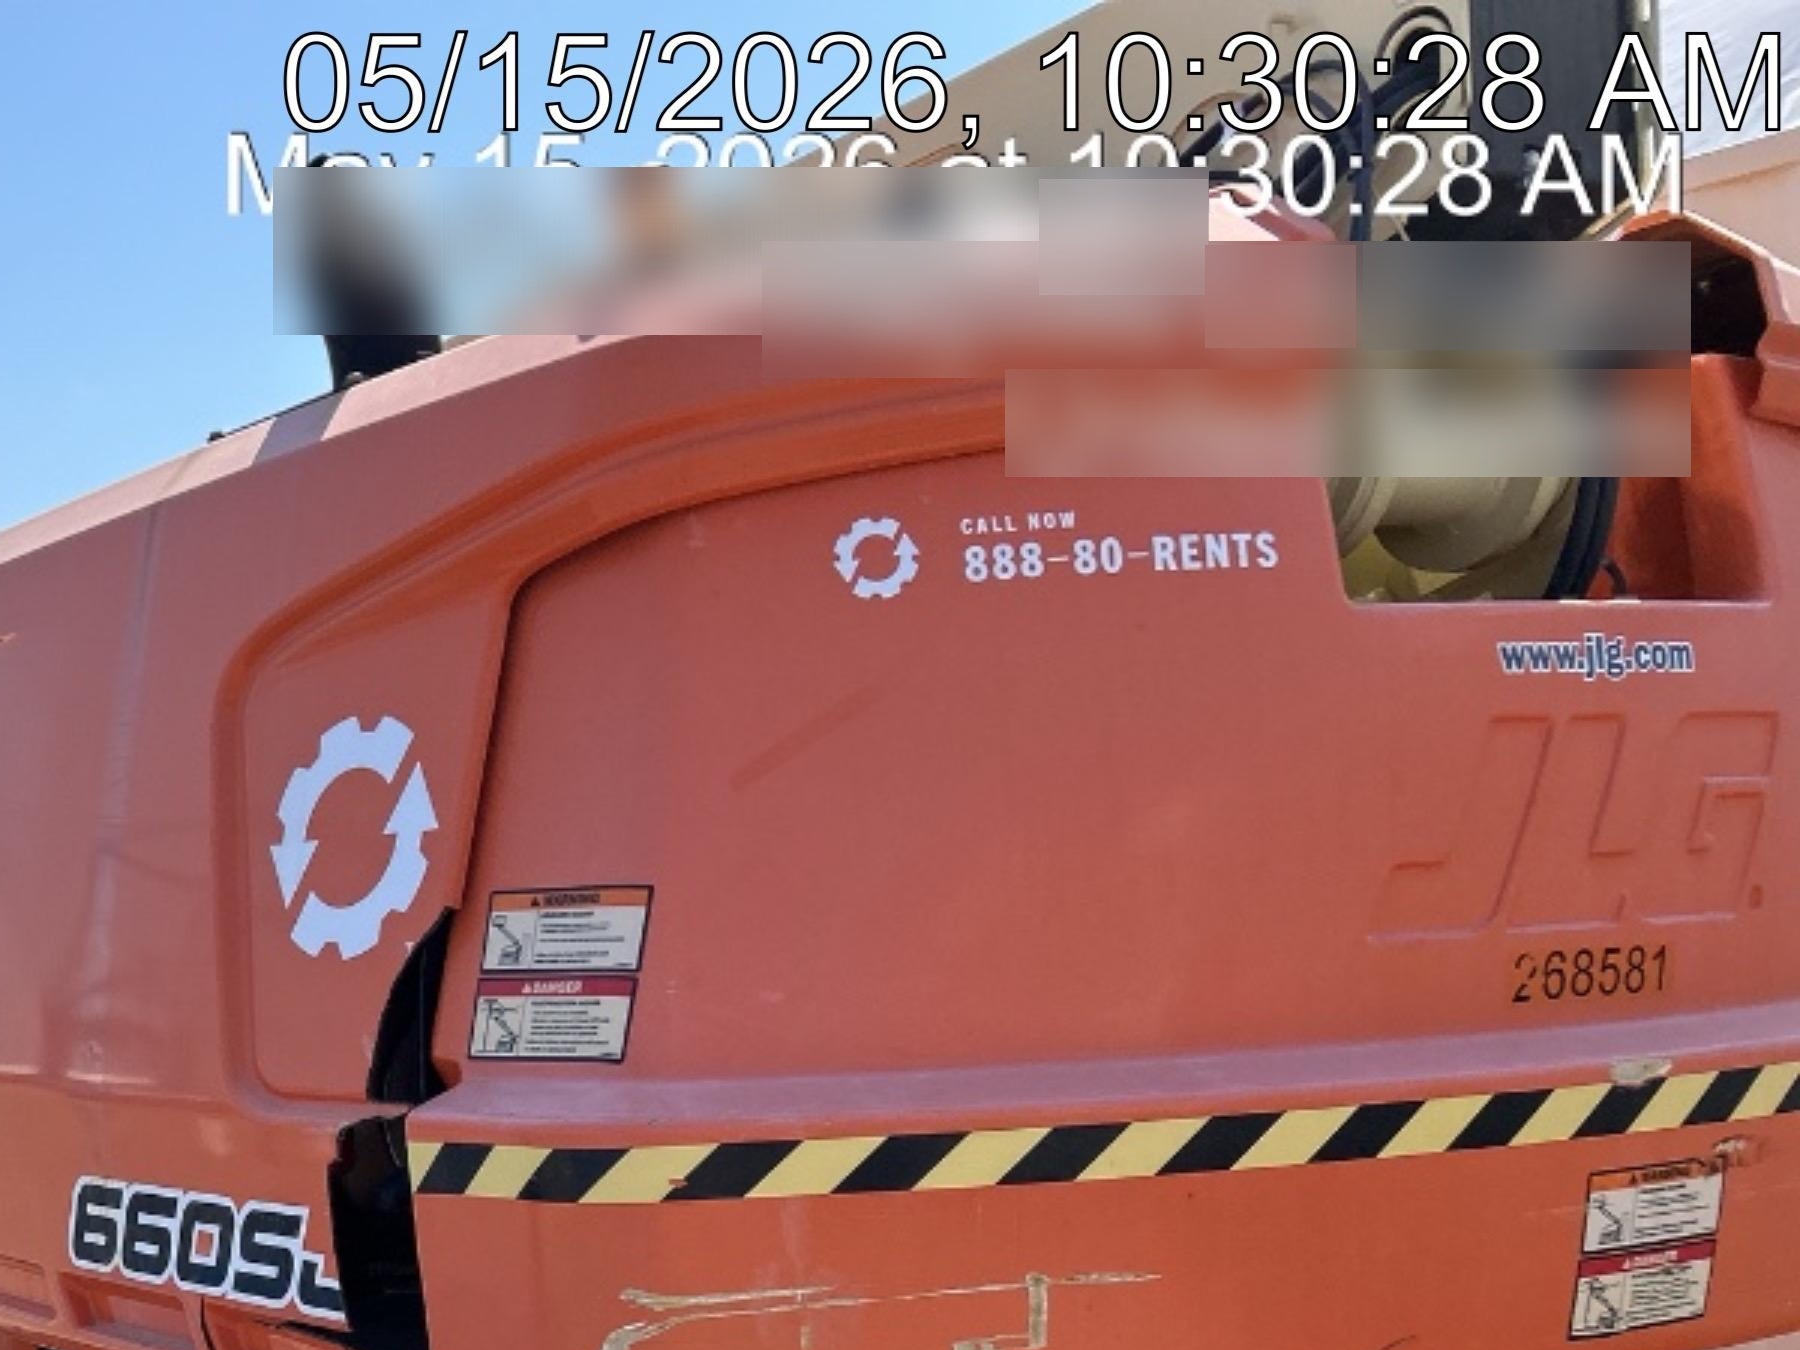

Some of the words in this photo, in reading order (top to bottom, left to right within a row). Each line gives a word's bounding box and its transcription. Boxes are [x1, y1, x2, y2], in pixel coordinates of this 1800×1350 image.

[960, 515, 1018, 535] CALL
[1026, 510, 1076, 531] NOW
[1498, 632, 1695, 681] www.jlg.com
[1511, 943, 1668, 1003] 268581
